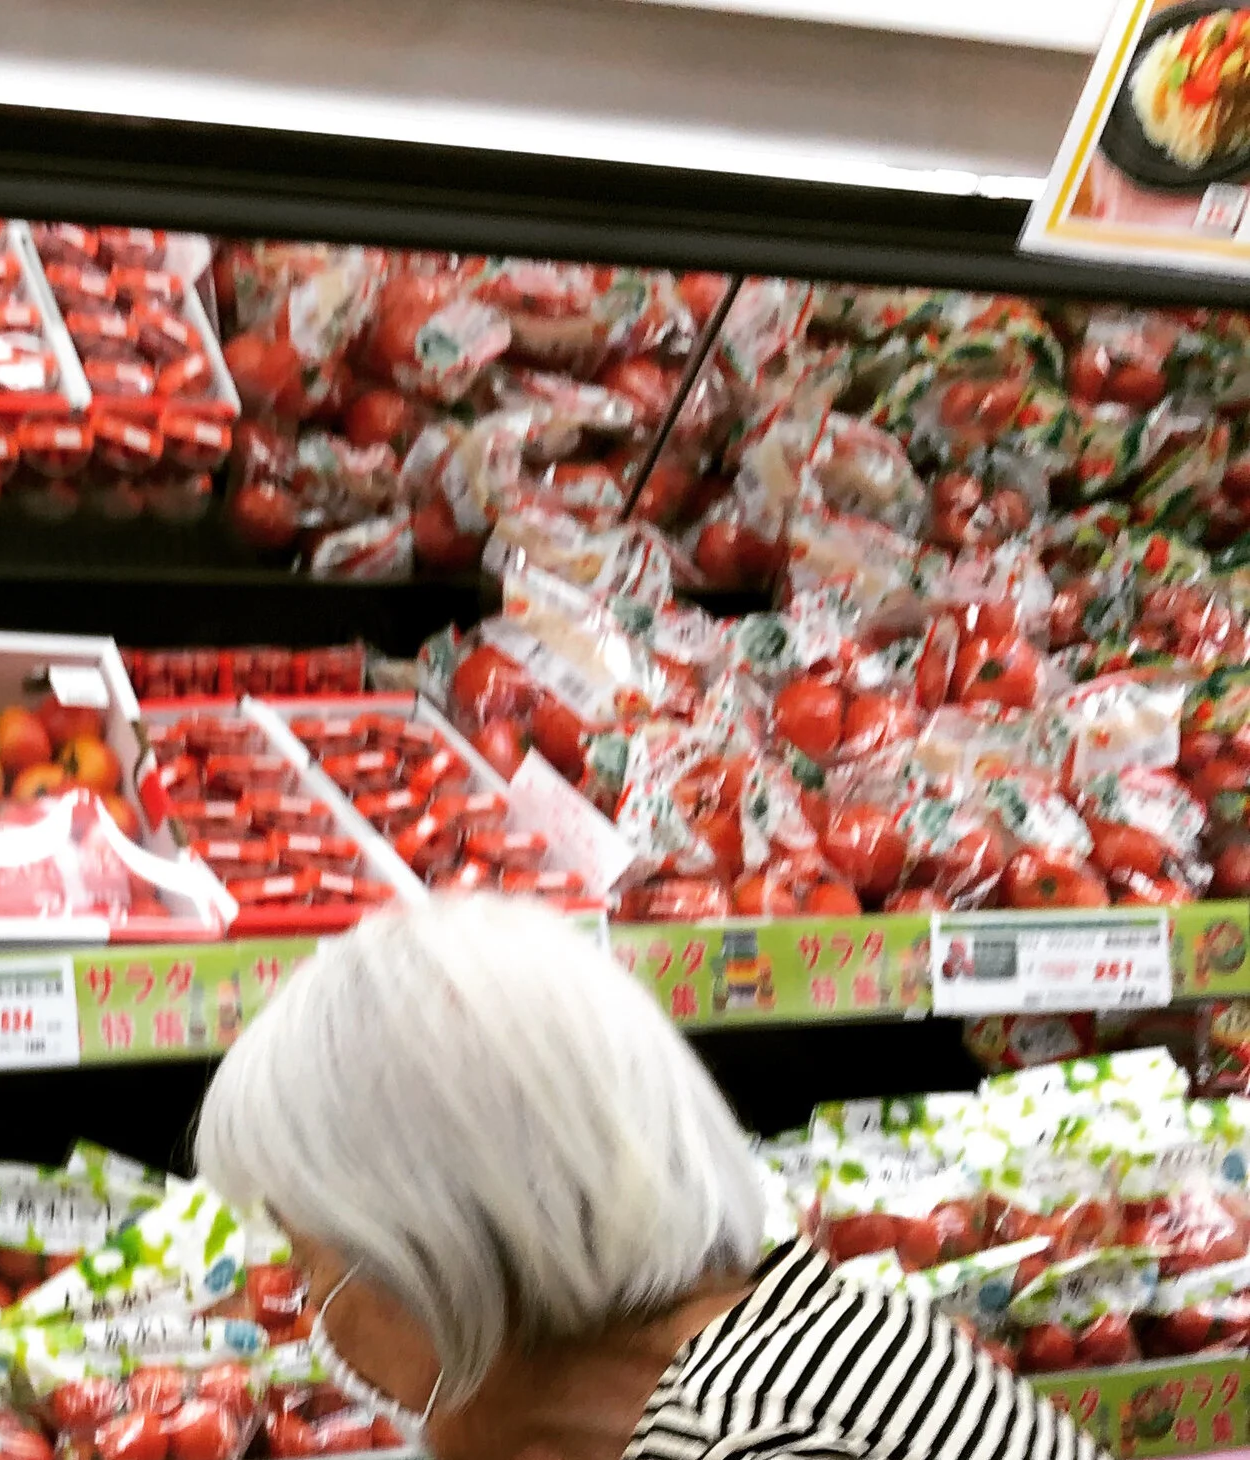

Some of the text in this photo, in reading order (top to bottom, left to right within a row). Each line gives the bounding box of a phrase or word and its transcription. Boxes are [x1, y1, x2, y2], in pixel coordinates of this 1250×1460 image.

[798, 929, 884, 970] サラダ
[84, 958, 194, 1006] サラダ
